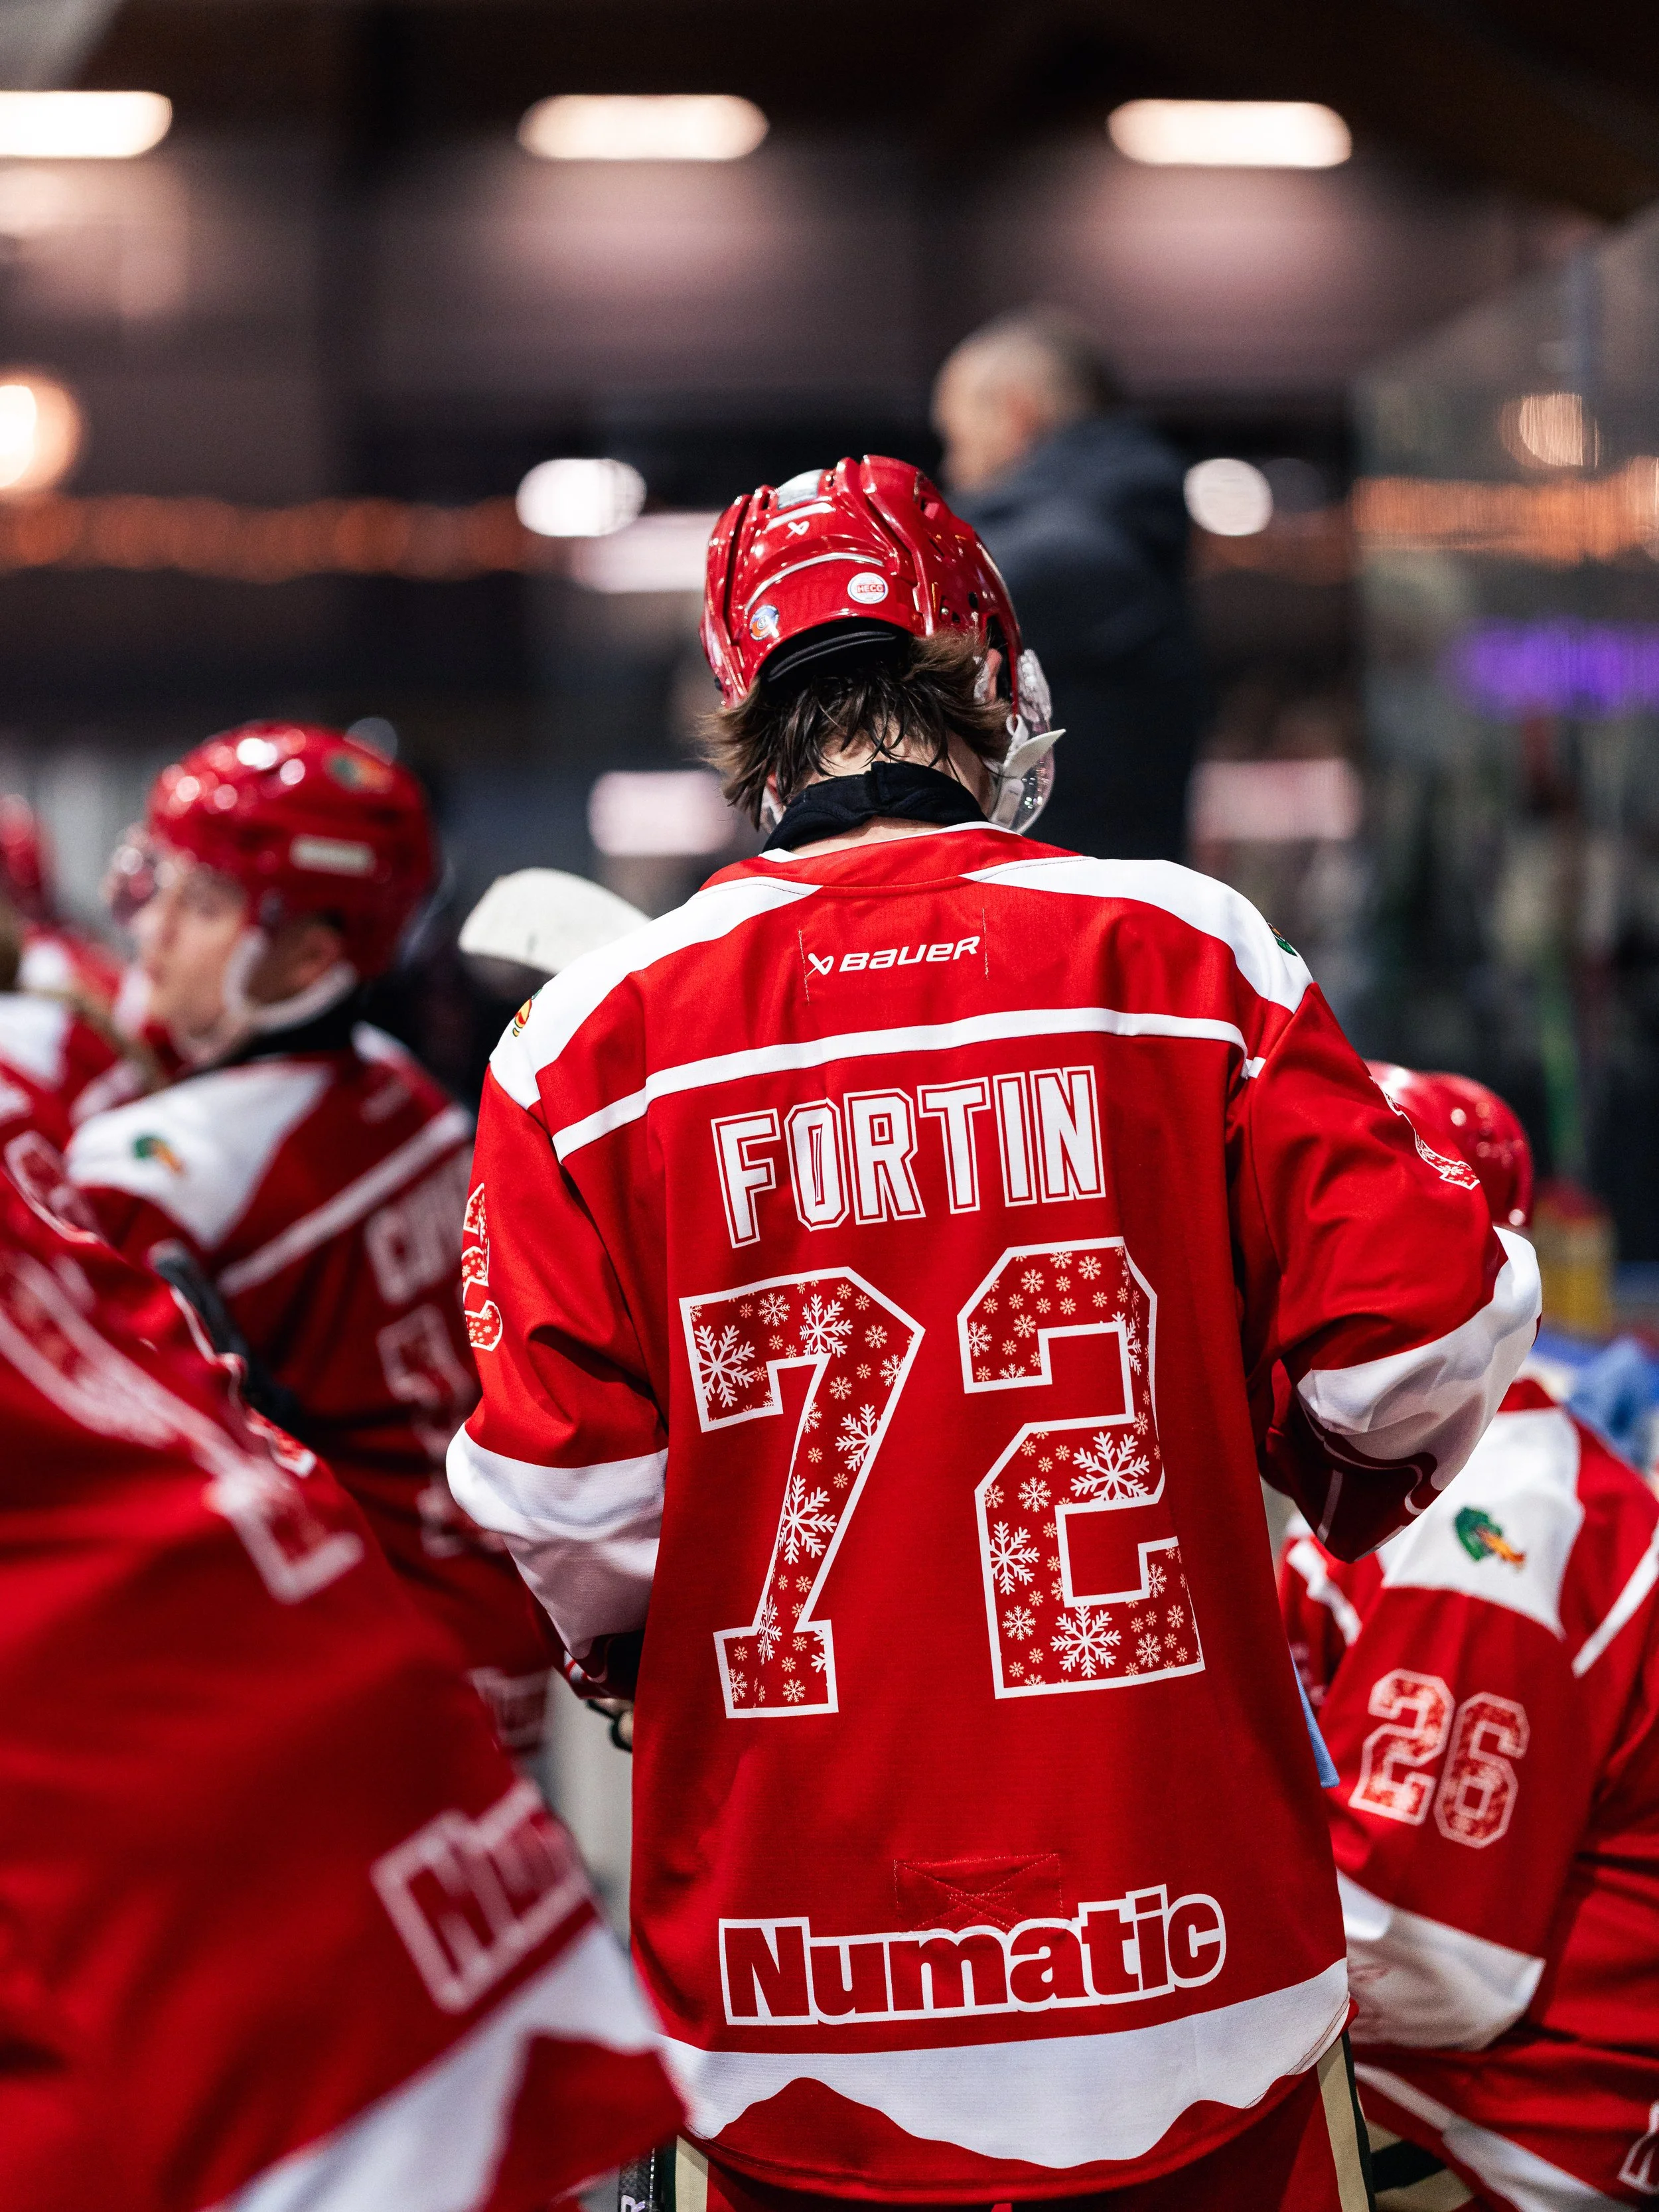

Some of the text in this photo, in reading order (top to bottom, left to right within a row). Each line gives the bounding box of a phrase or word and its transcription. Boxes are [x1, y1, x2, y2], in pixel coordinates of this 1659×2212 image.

[839, 936, 980, 972] BAUER
[711, 1065, 1107, 1249] FORTIN
[678, 1236, 1206, 1719] 72
[1348, 1668, 1530, 1850] 26
[719, 1883, 1226, 2026] Numatic
